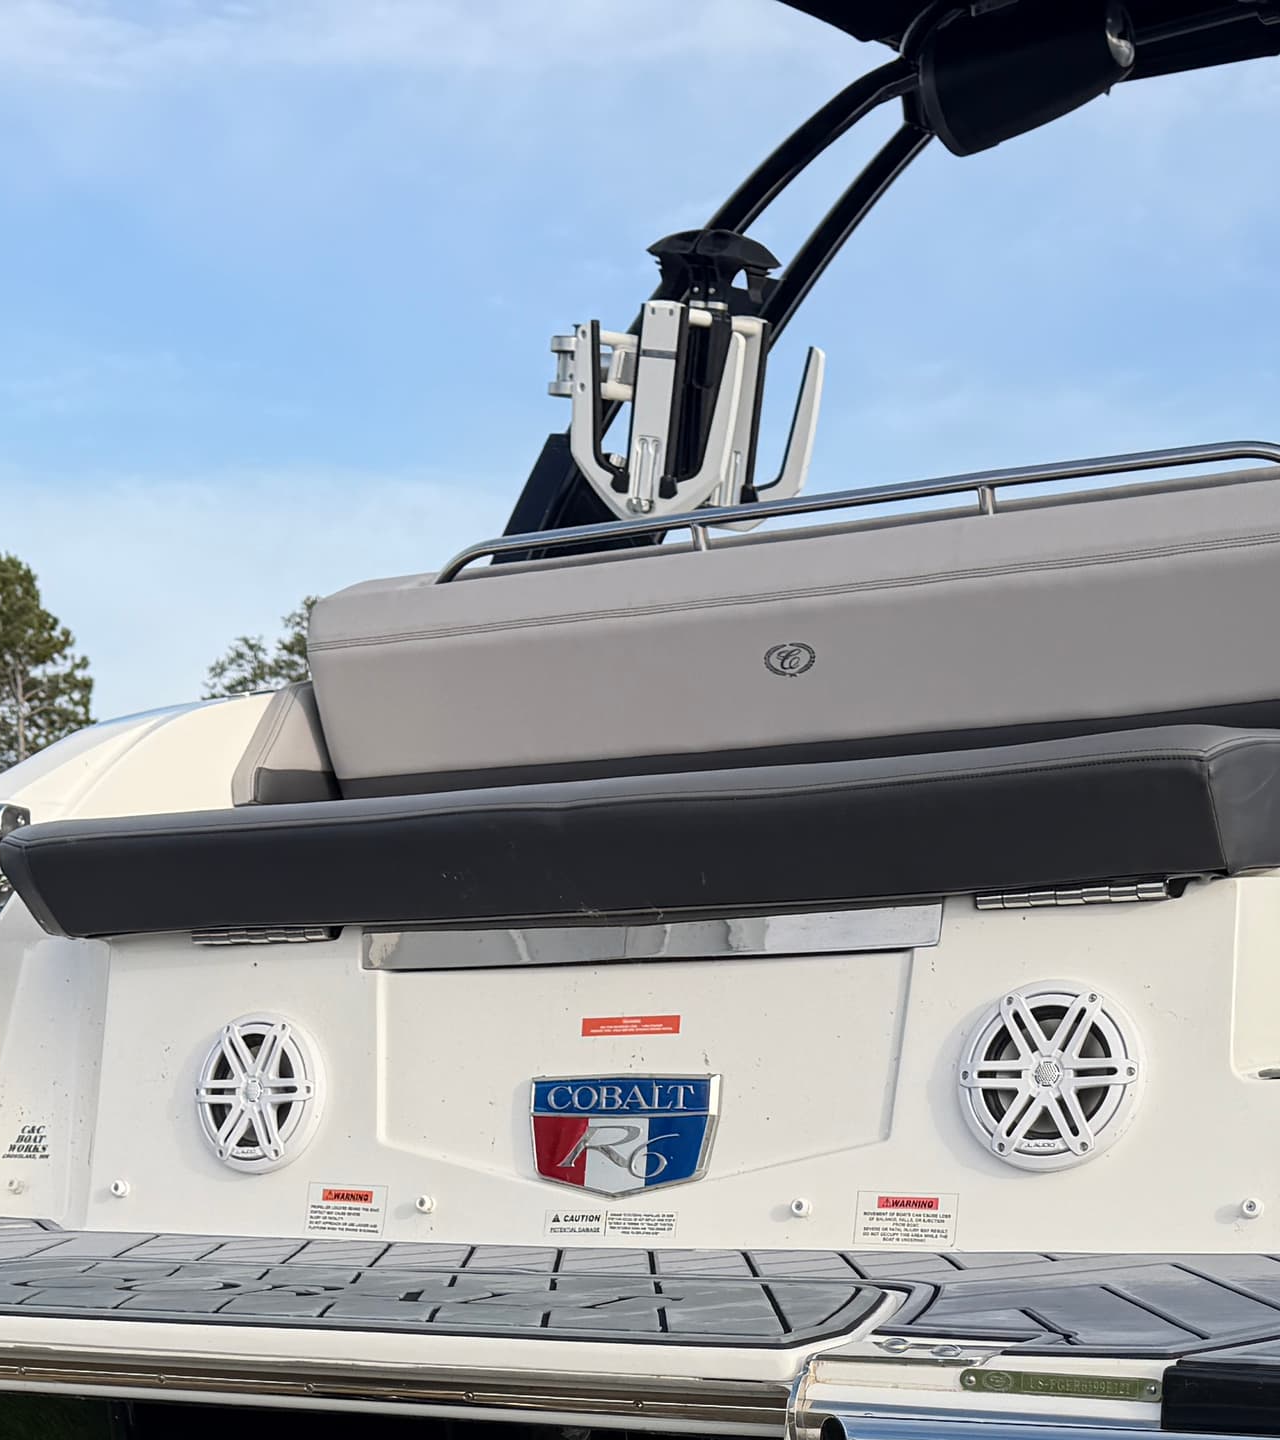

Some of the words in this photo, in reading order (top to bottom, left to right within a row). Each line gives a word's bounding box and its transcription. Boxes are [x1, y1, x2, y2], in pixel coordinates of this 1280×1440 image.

[547, 1081, 695, 1110] COBALT
[16, 1135, 47, 1143] BOAT
[8, 1144, 48, 1153] WORKS
[556, 1125, 680, 1179] R6
[333, 1191, 369, 1202] WARNING
[890, 1199, 934, 1209] WARNING
[563, 1214, 601, 1223] CAUTION
